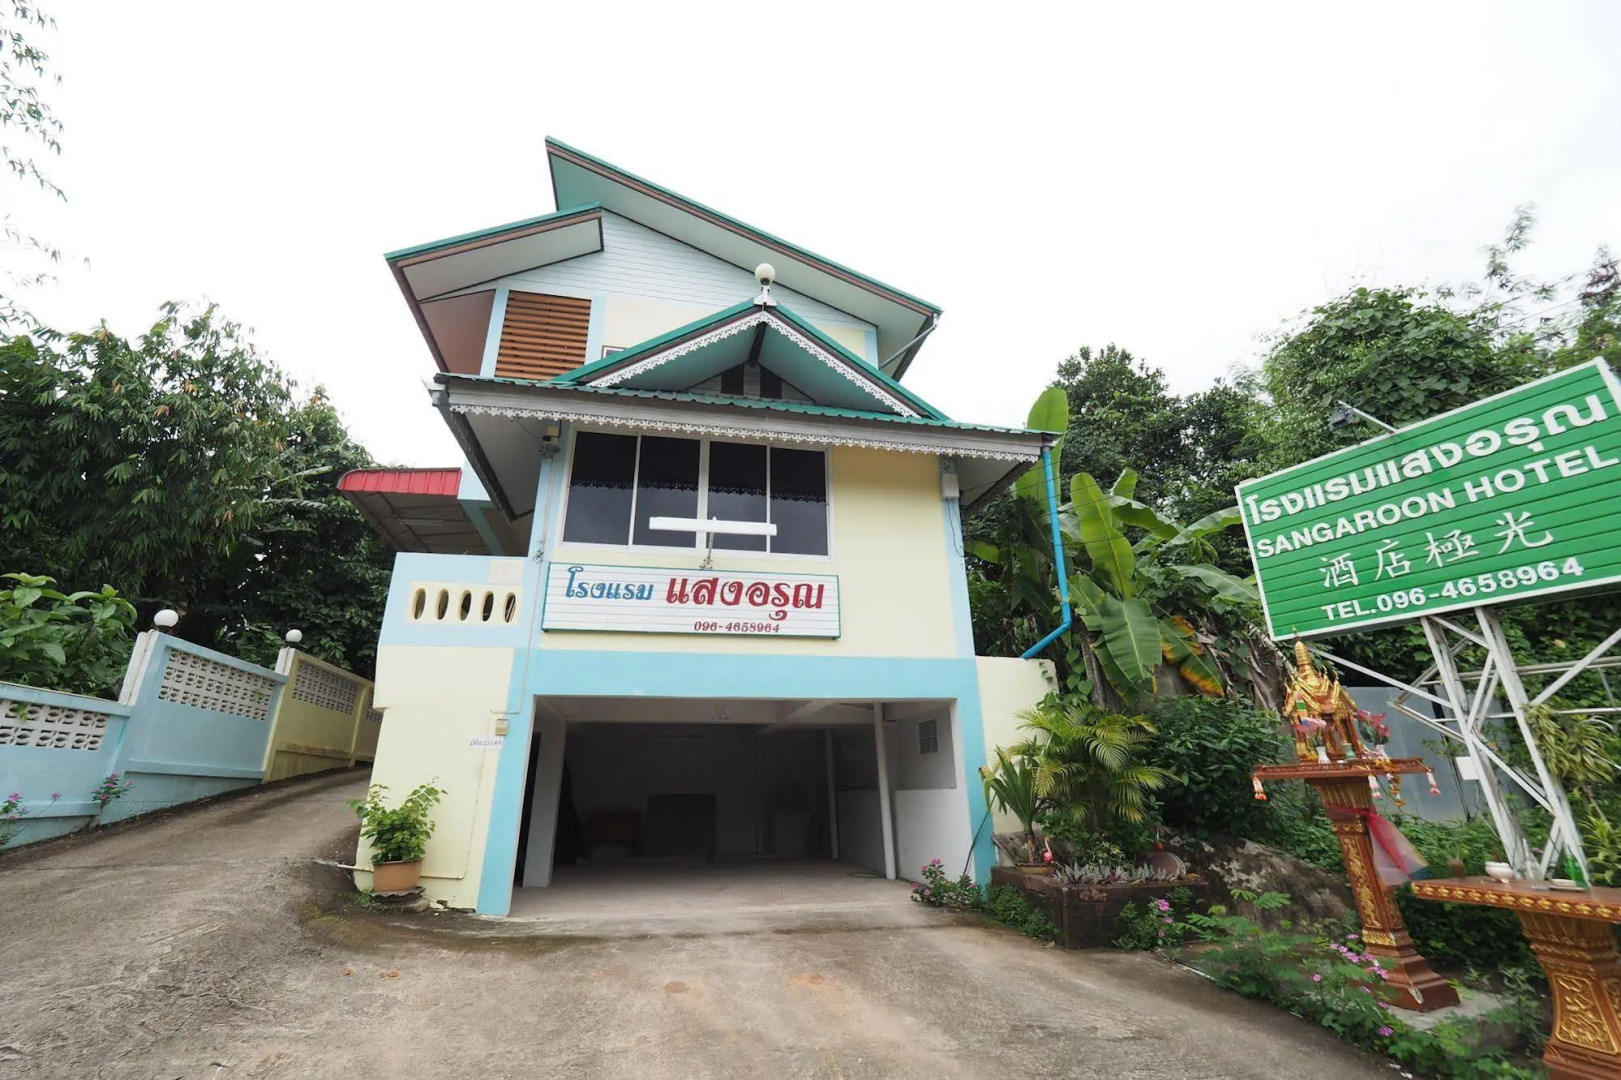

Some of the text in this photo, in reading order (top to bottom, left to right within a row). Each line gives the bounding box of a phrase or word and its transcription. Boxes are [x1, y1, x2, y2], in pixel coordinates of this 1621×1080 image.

[1256, 446, 1620, 558] SANGAROON HOTEL
[565, 565, 825, 621] โรงแรม แสงอรุณ
[694, 621, 780, 633] 096-4658964
